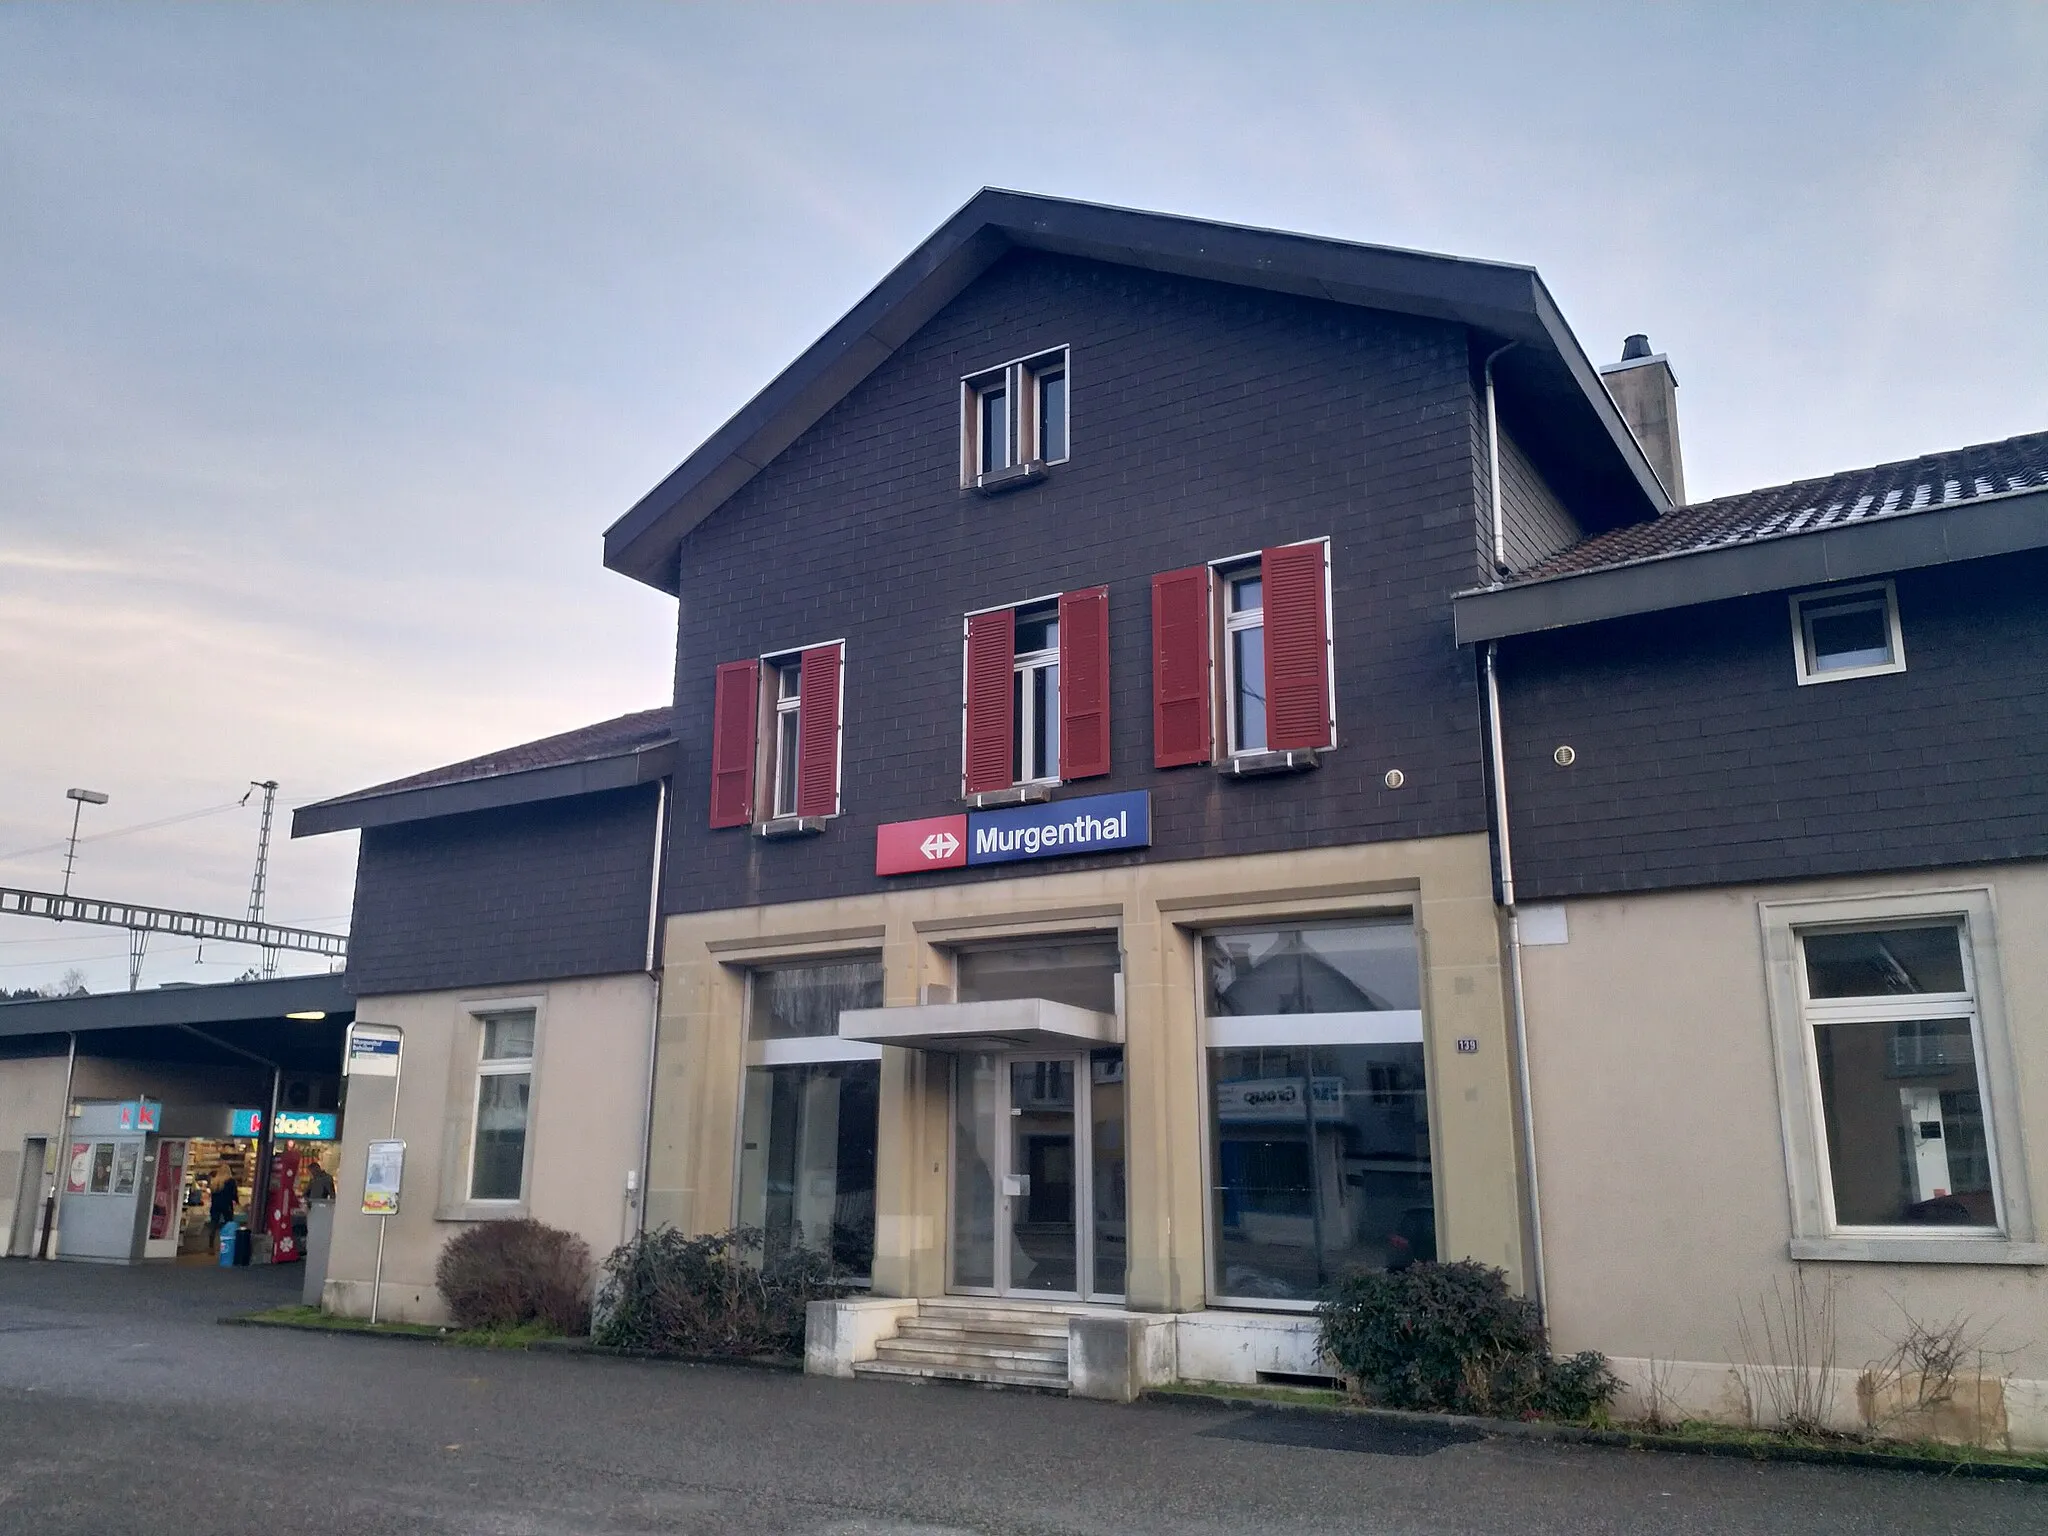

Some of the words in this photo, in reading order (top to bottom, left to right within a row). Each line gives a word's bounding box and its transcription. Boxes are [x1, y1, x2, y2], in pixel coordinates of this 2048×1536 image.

[976, 810, 1127, 854] Murgenthal
[1459, 1040, 1476, 1051] 139
[139, 1105, 154, 1124] k
